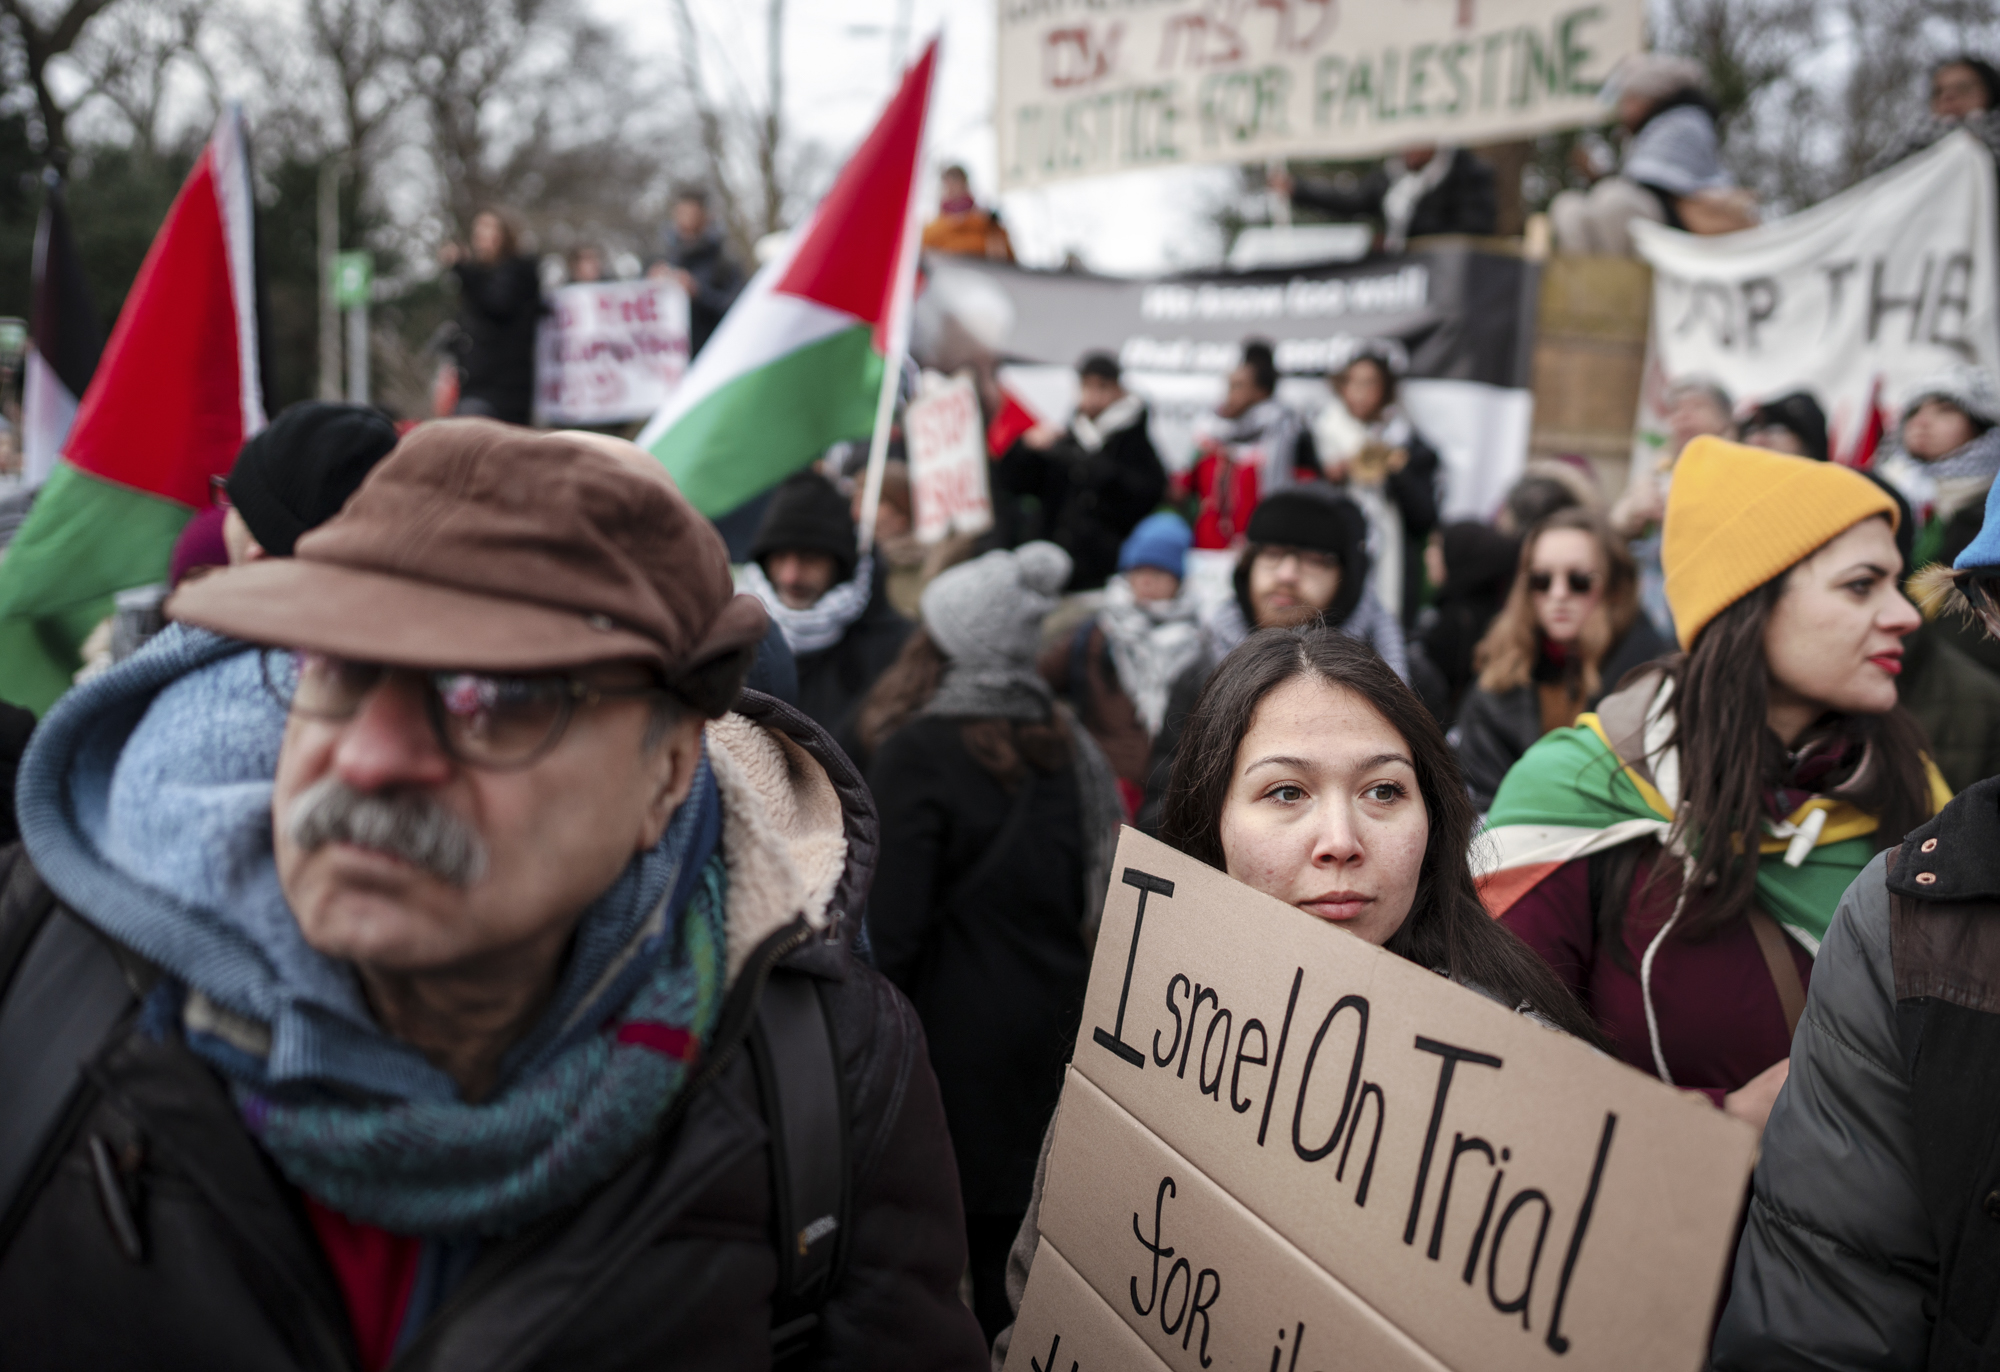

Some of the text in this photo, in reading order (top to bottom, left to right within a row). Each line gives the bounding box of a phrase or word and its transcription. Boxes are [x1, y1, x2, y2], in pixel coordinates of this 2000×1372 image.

[1010, 4, 1607, 178] JUSTICE FOR PALESTINE
[1092, 867, 1618, 1355] Israel On Trial
